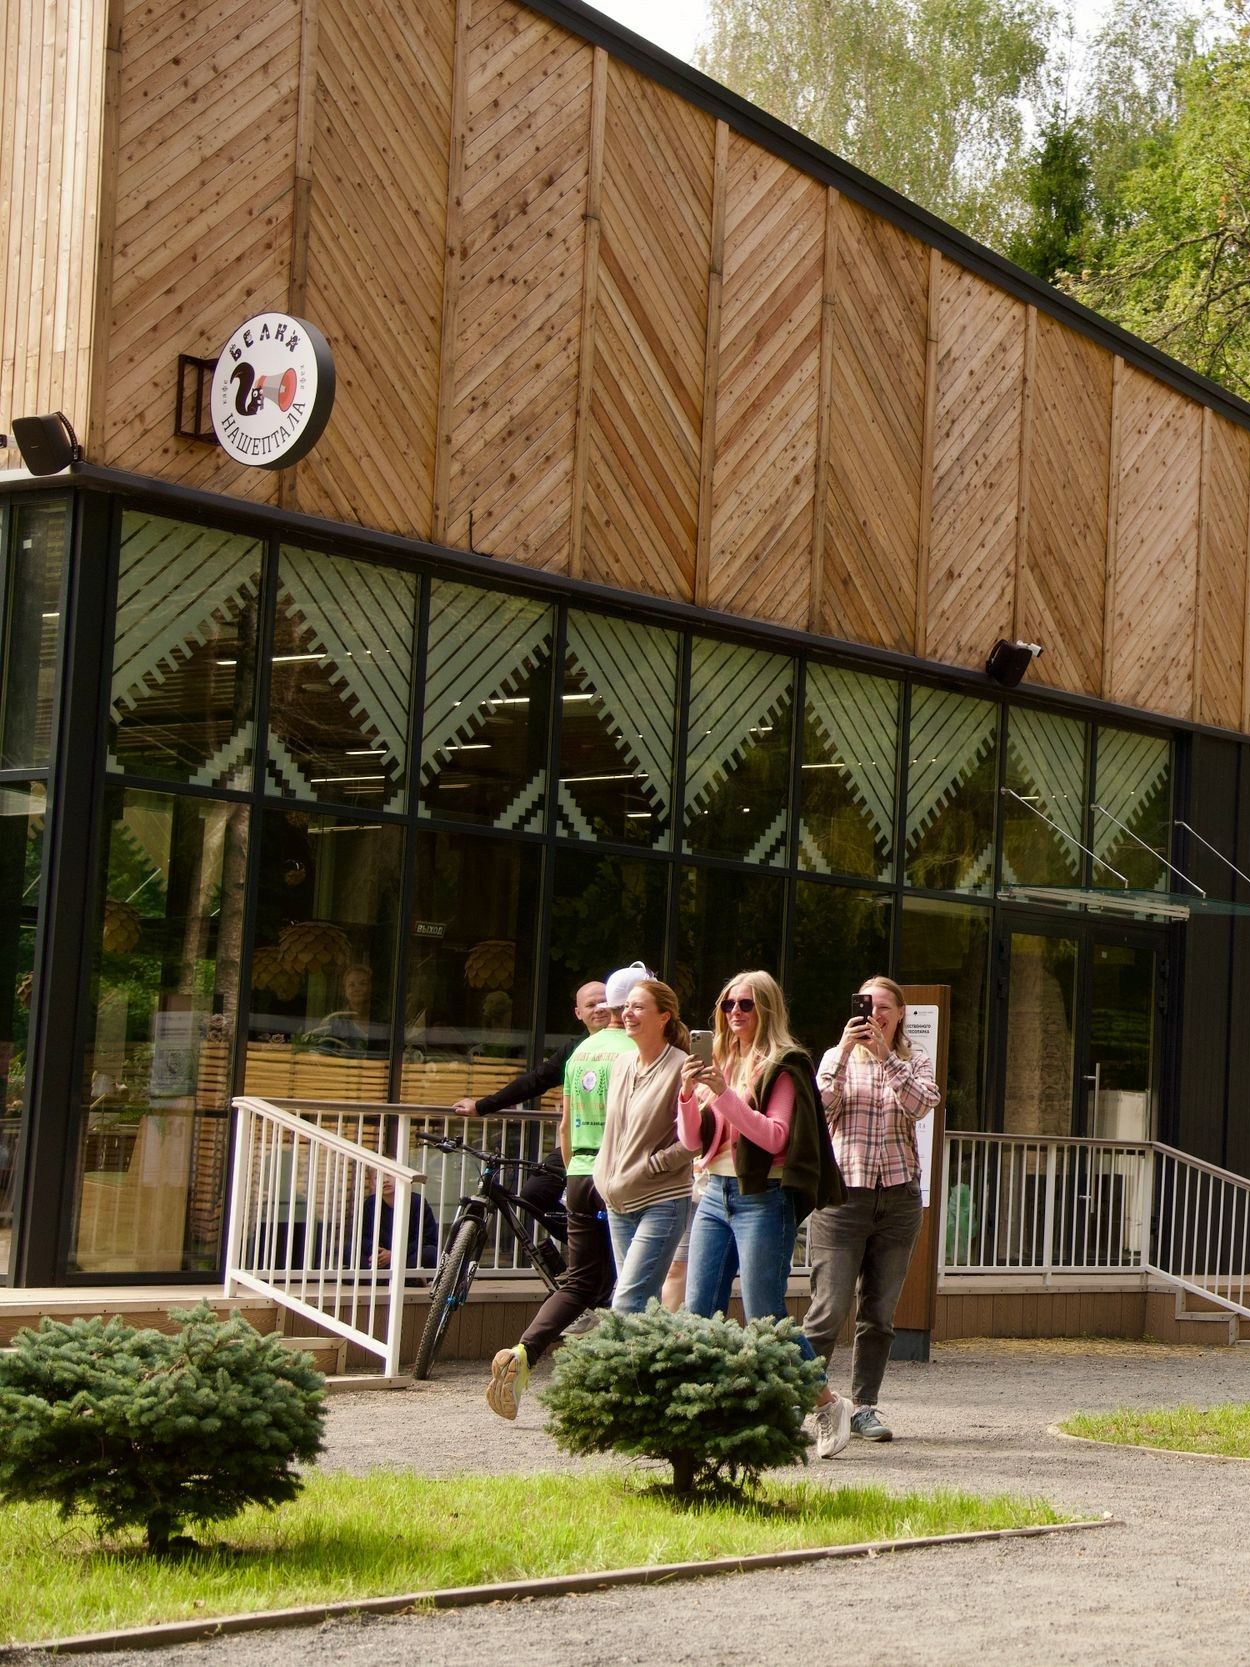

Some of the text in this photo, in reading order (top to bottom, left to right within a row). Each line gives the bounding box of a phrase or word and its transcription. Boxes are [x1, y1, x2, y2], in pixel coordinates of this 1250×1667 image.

[228, 322, 302, 362] БЕЛКА
[221, 402, 306, 456] НАШЕПТАЛА
[416, 924, 443, 936] ВЫХОД
